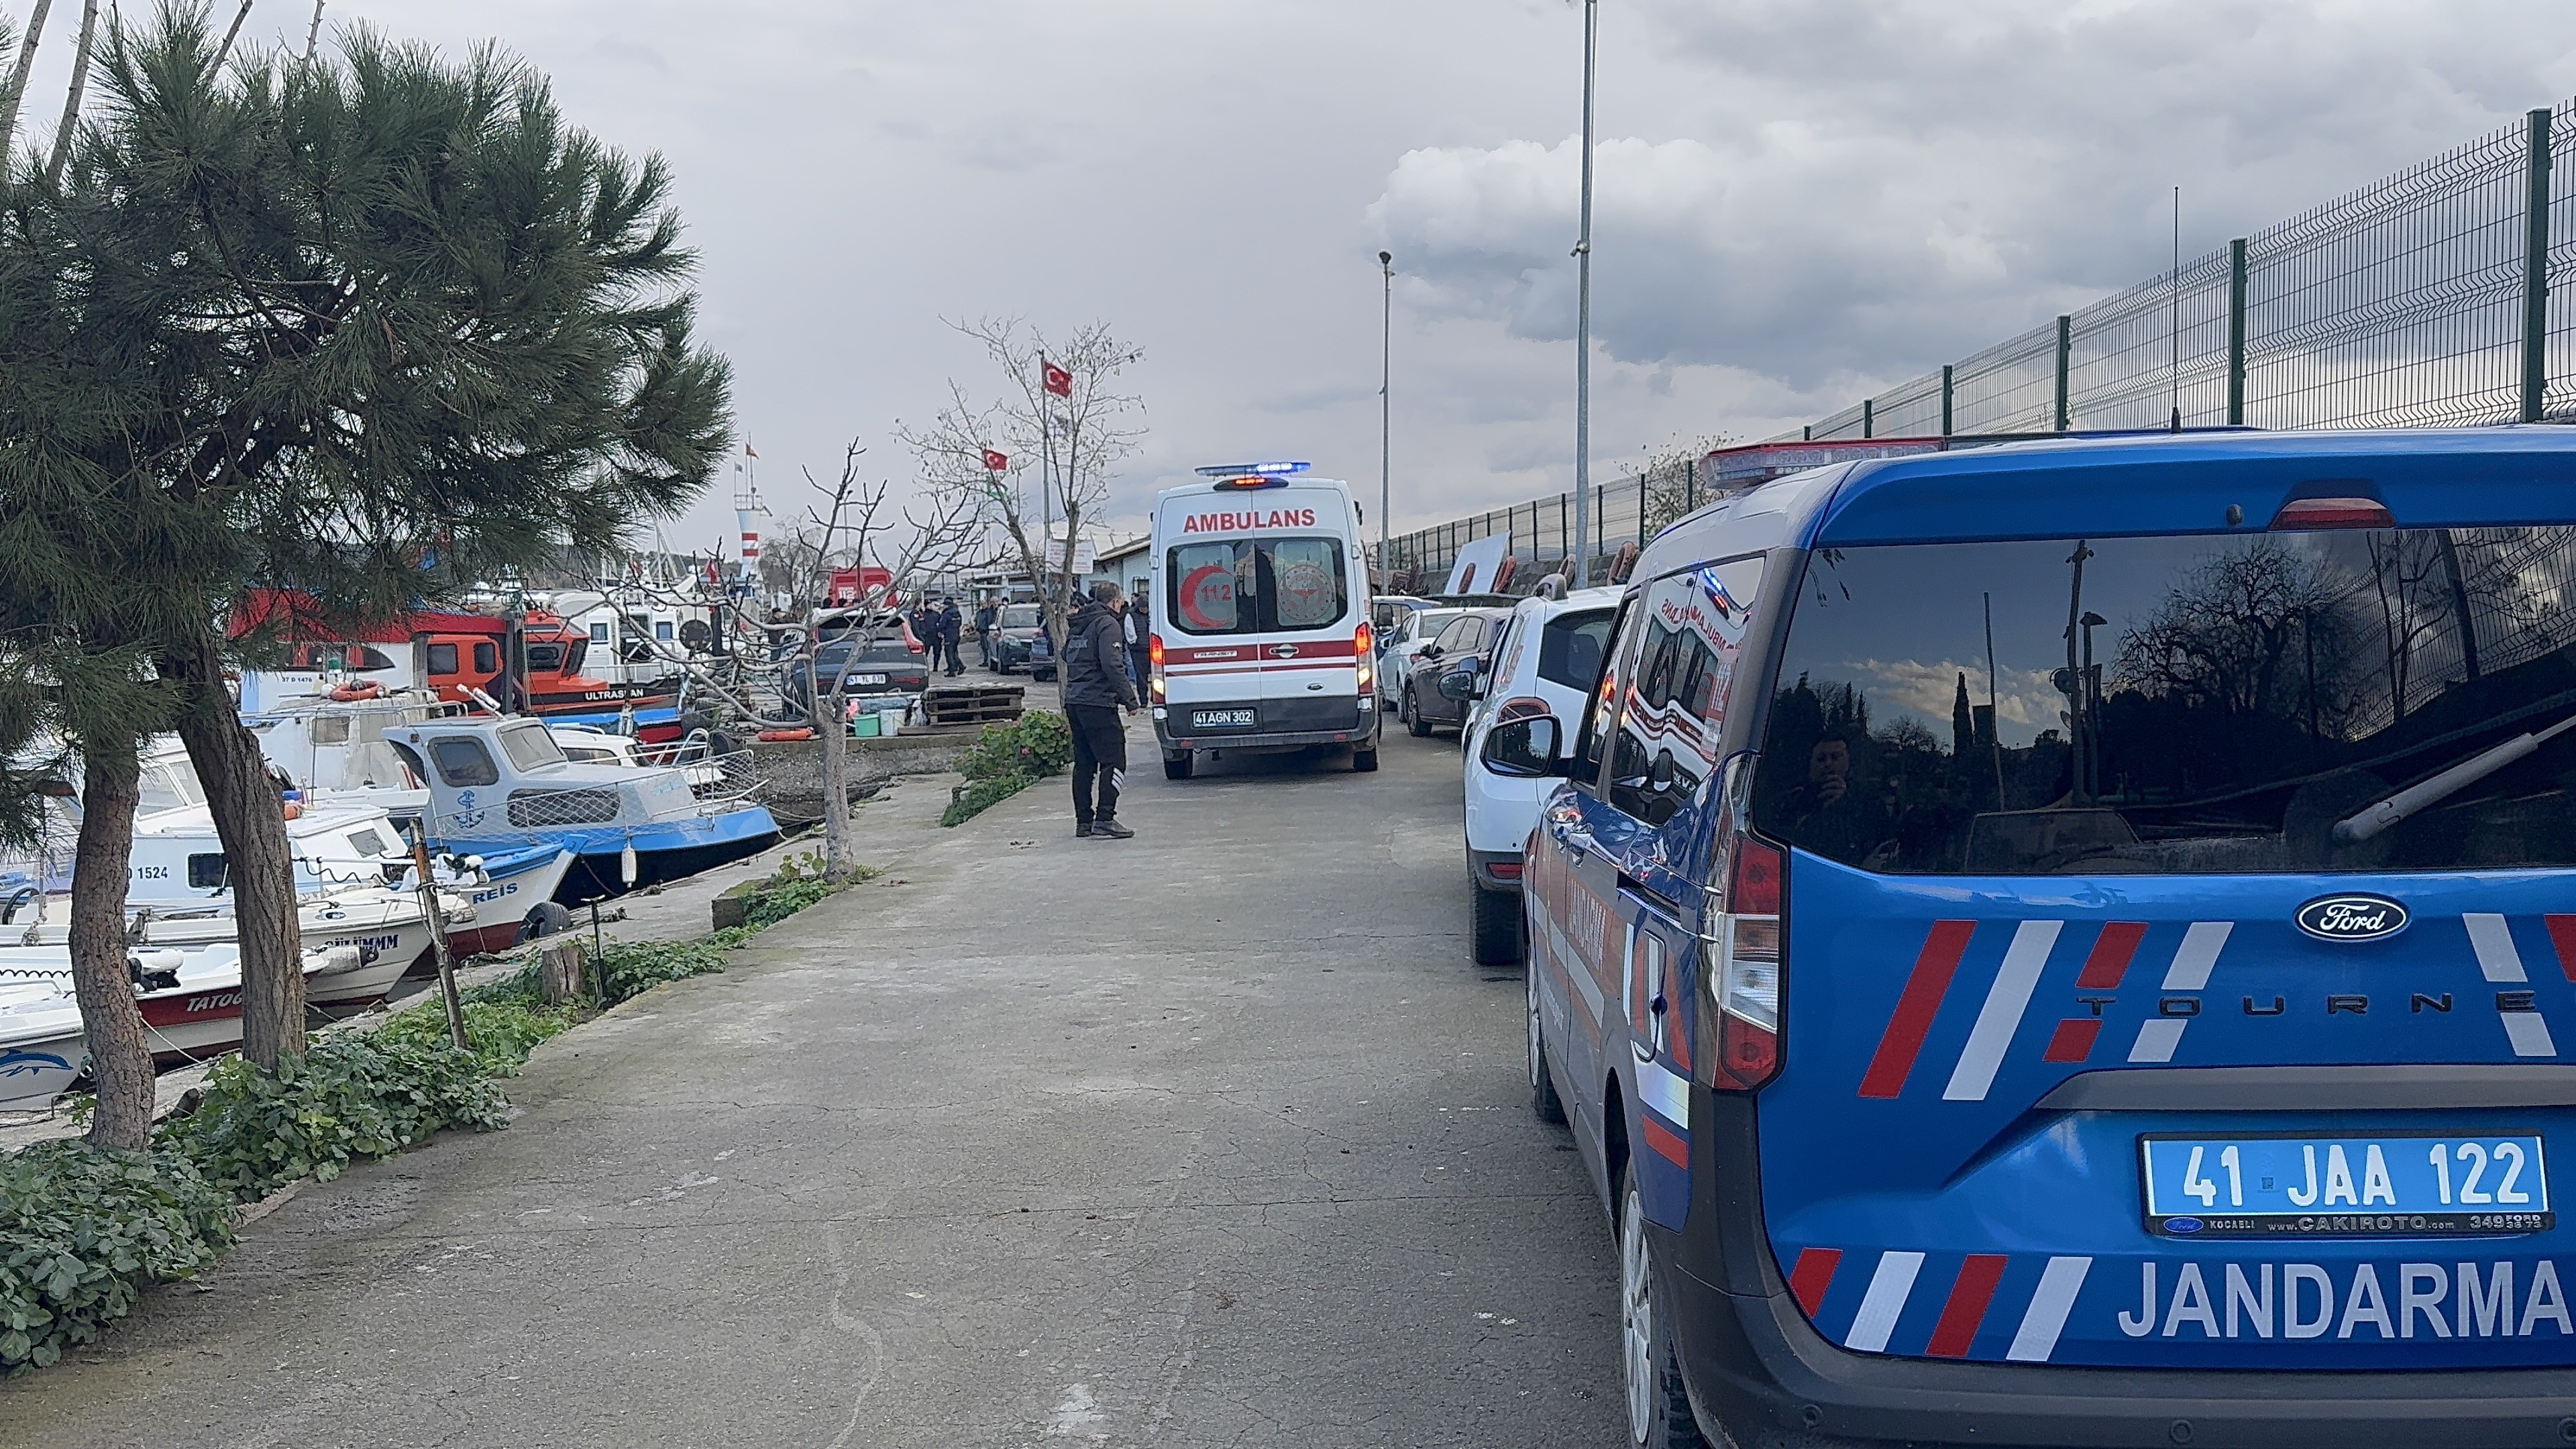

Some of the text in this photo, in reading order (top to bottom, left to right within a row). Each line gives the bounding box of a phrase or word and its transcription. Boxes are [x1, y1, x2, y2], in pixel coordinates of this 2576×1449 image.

[1183, 508, 1316, 533] AMBULANS
[1201, 584, 1232, 602] 112
[585, 688, 644, 700] ULTRASAN
[1195, 710, 1252, 723] 41 AGN 302
[138, 866, 168, 879] 1524
[2320, 904, 2387, 932] Ford
[2076, 990, 2537, 1017] TOURNE
[2183, 1142, 2529, 1207] 41 JAA 122
[2469, 1215, 2505, 1229] 349
[2118, 1260, 2574, 1339] JANDARMA
